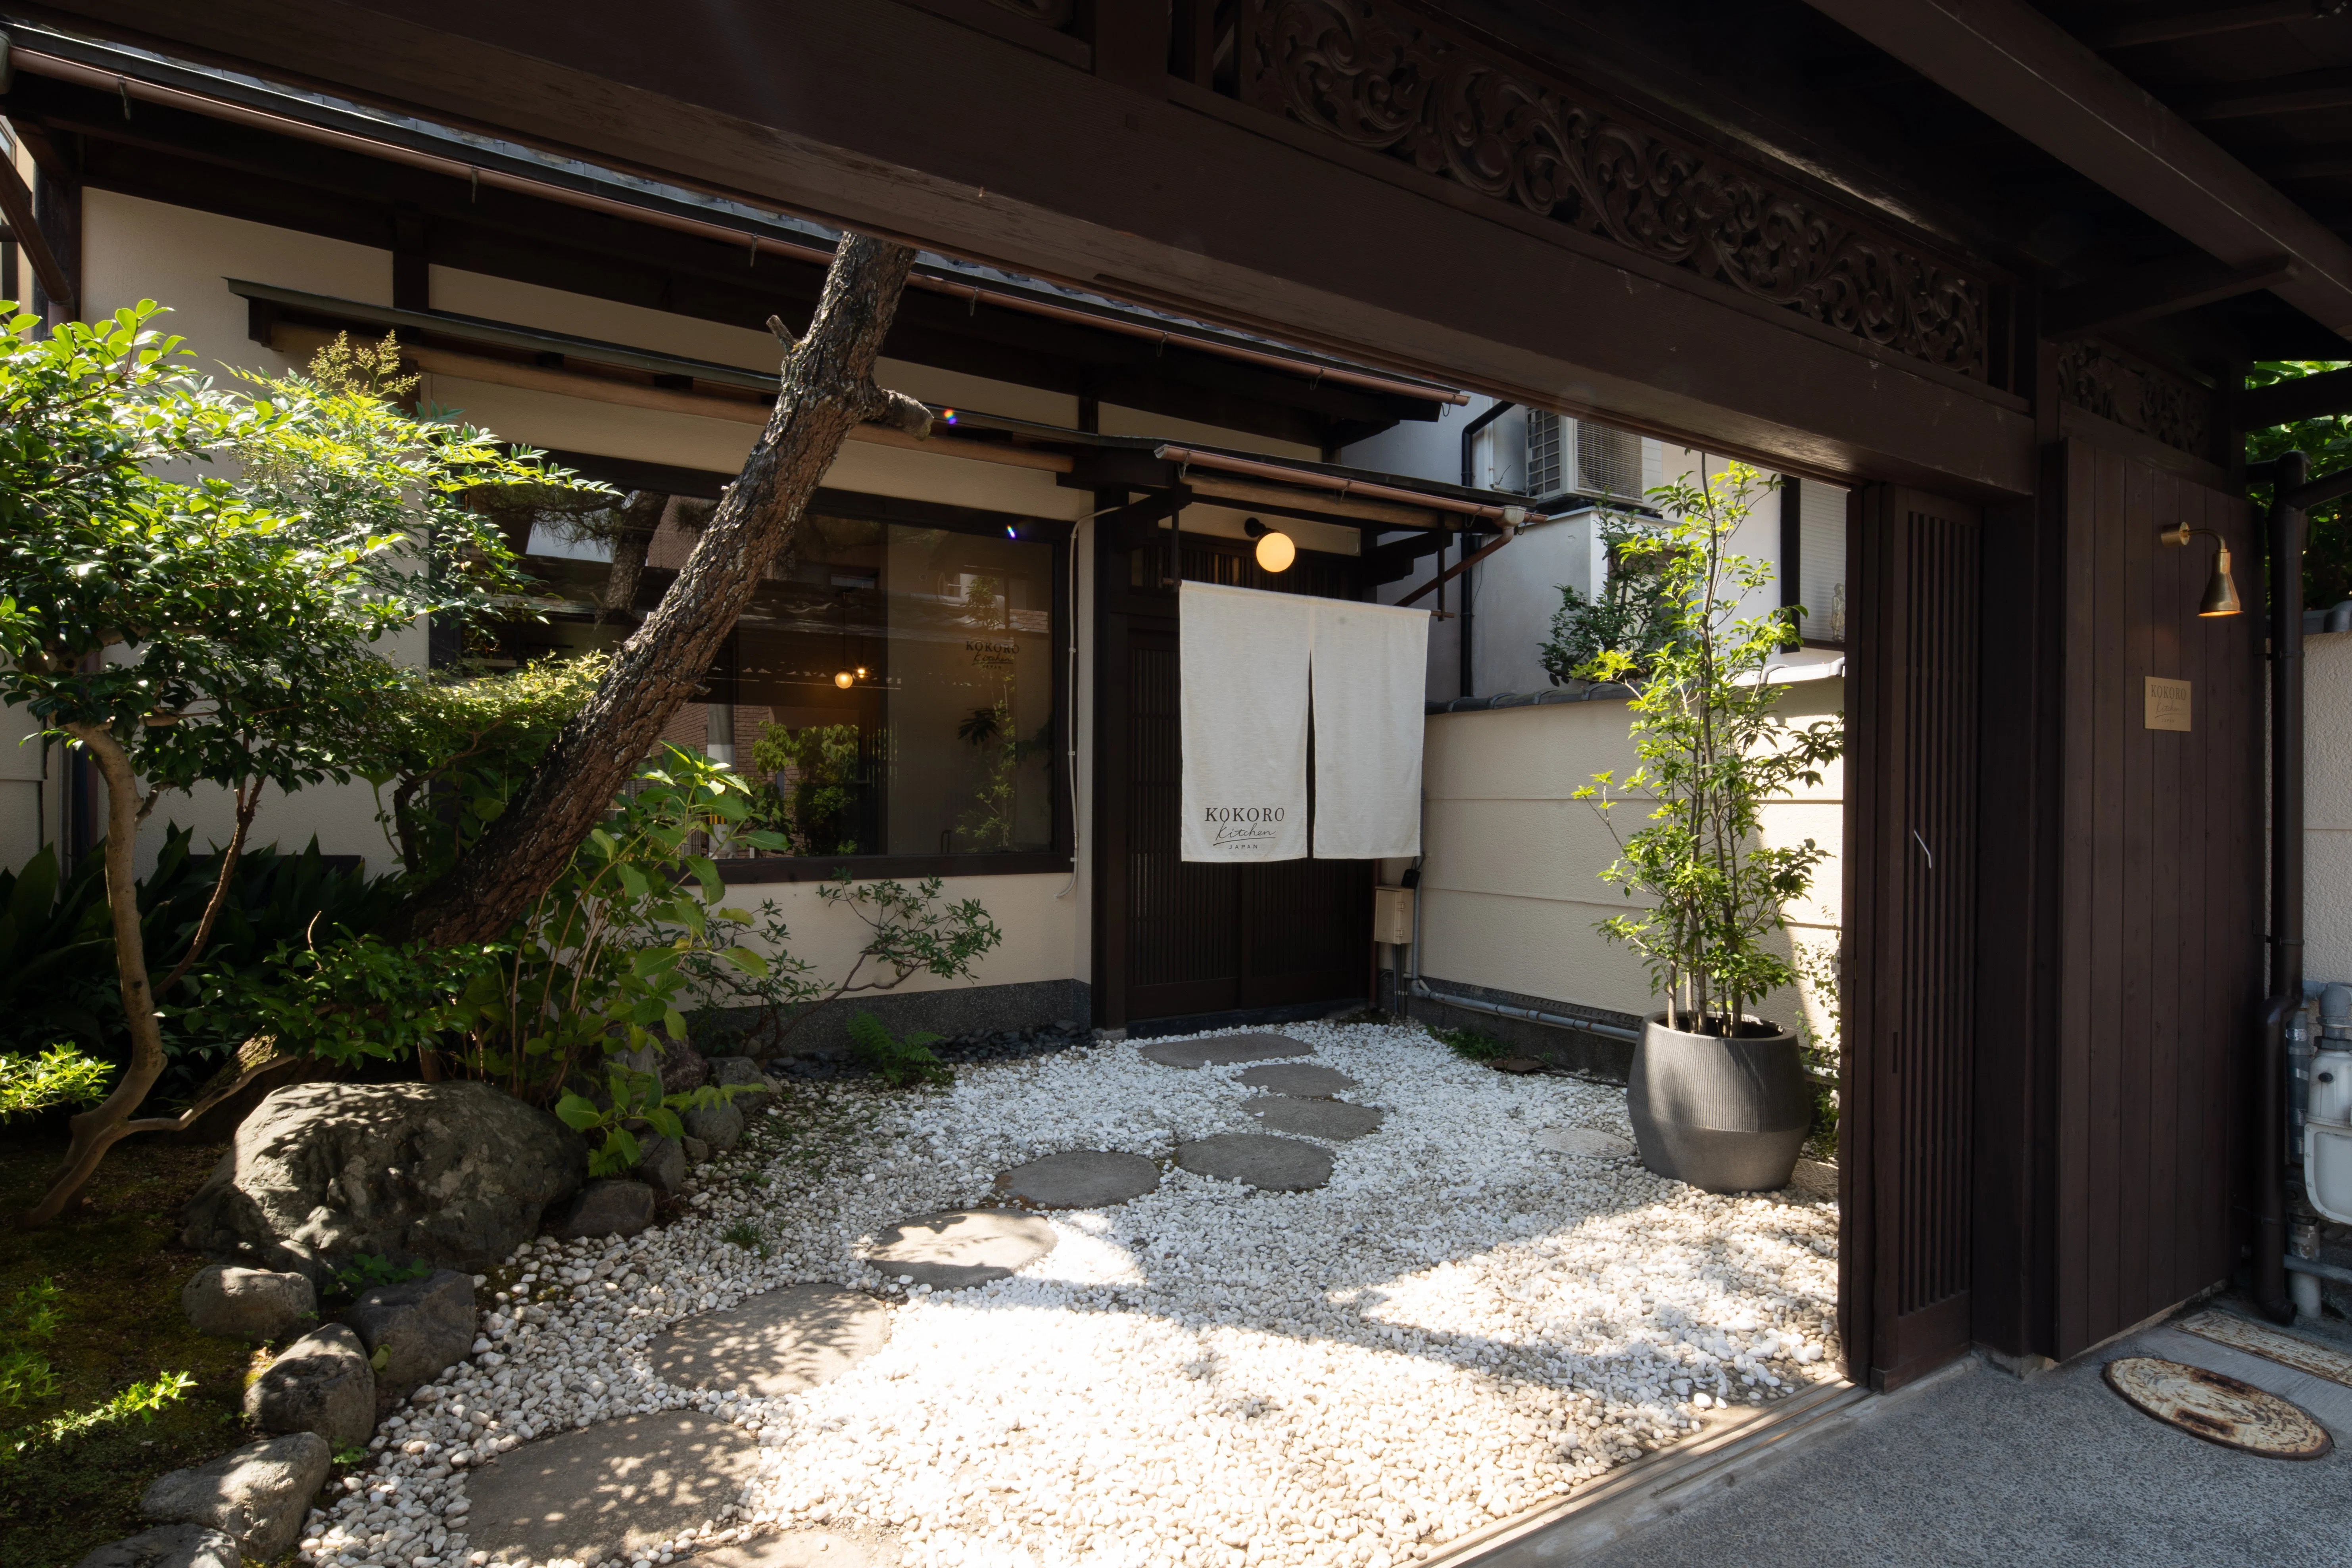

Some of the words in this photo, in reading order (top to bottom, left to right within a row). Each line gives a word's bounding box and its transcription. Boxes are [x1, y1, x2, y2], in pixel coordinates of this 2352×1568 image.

[966, 641, 1020, 654] KOKORO
[2151, 685, 2186, 701] KOKORO
[1204, 808, 1284, 821] KOKORO
